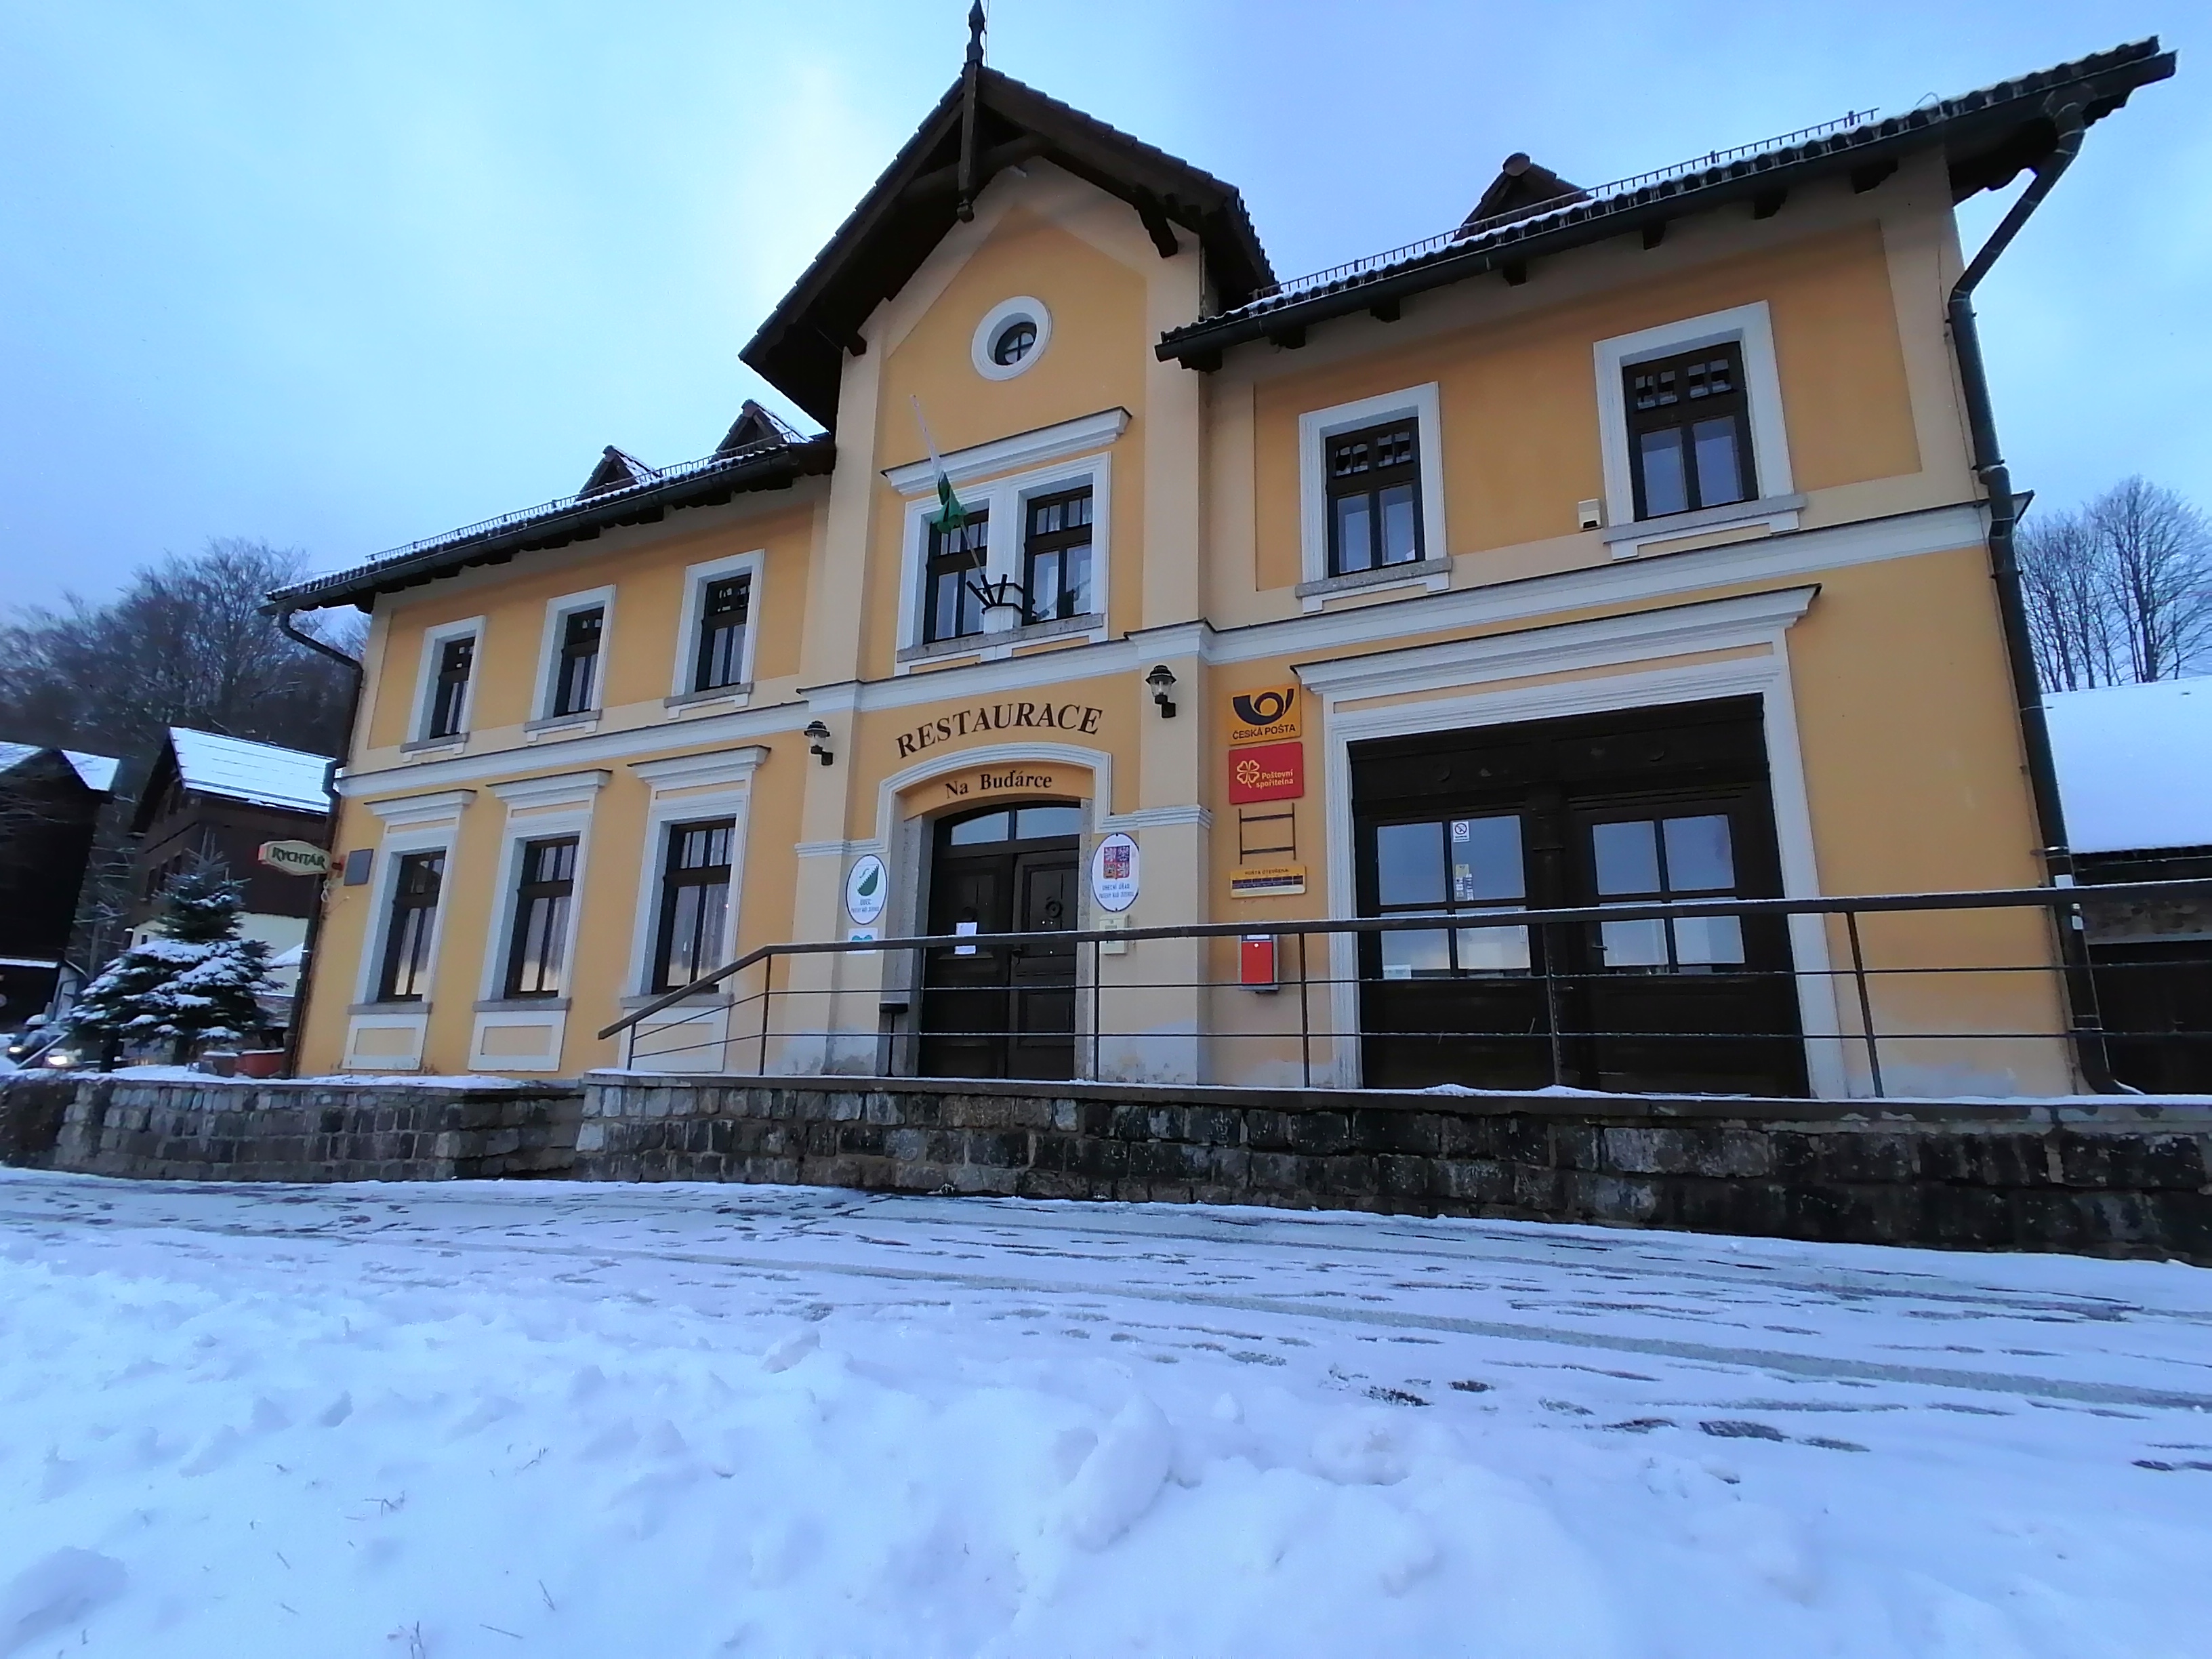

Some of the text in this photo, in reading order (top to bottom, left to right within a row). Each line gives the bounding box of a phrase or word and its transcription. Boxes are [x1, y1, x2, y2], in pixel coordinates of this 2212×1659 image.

[895, 702, 1103, 759] RESTAURACE
[1232, 723, 1296, 739] ČESKÁ POŠTA
[1262, 769, 1293, 779] Poštovní
[945, 770, 1052, 799] Na Buďárce
[1256, 777, 1294, 790] spořitelna
